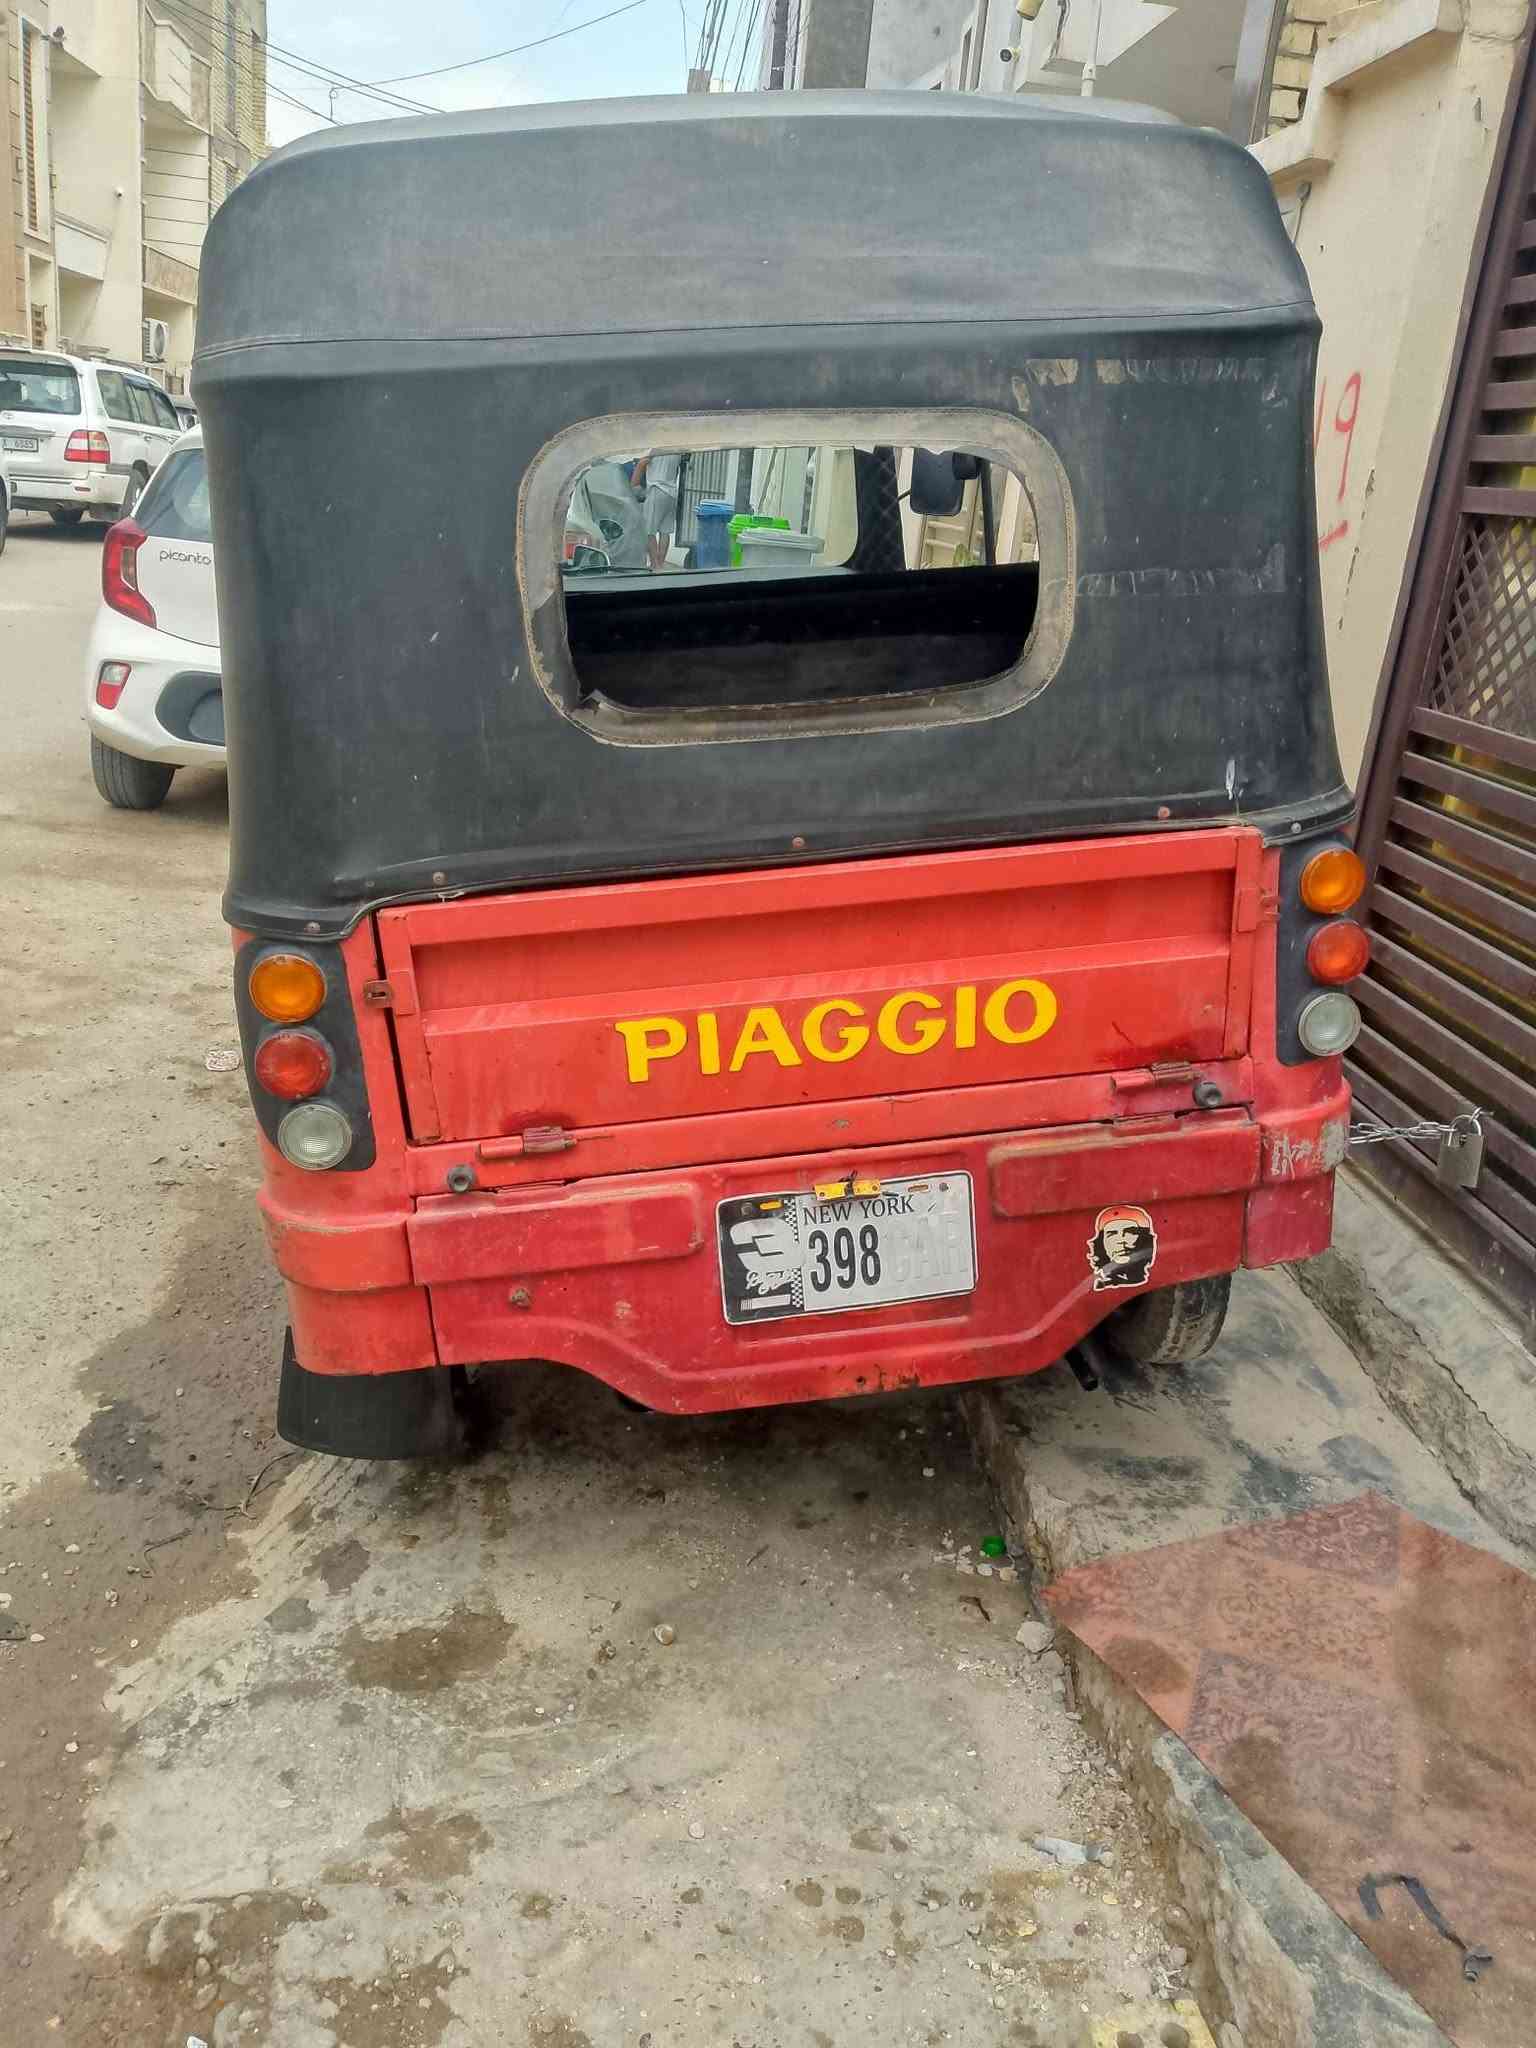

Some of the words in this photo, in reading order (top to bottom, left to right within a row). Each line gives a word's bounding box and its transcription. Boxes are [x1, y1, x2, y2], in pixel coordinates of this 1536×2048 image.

[159, 550, 212, 566] picanto
[614, 978, 1058, 1083] PIAGGIO
[803, 1202, 853, 1225] NEW
[860, 1194, 914, 1219] YORK
[808, 1223, 881, 1293] 398
